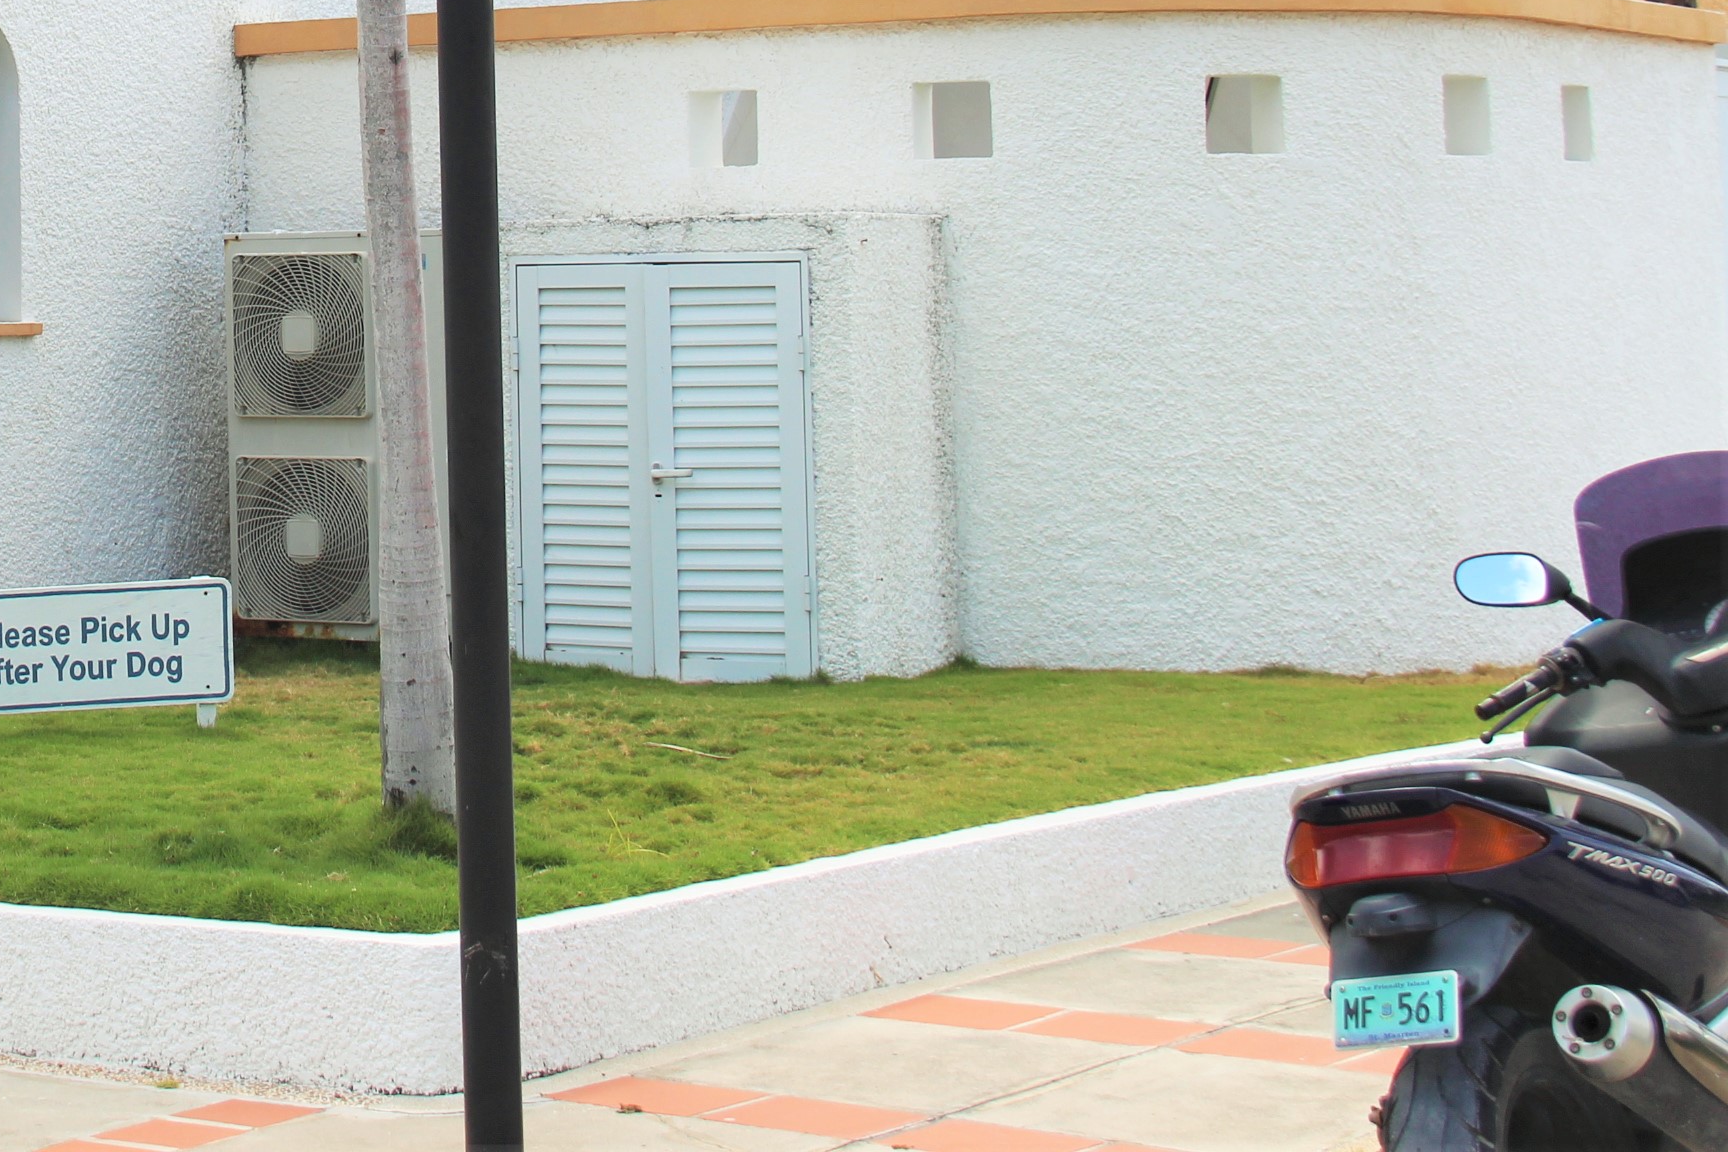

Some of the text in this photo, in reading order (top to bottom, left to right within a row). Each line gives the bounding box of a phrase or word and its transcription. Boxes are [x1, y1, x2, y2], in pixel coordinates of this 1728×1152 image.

[80, 614, 142, 644] Pick
[151, 613, 190, 646] Up
[51, 654, 117, 682] Your
[126, 651, 183, 684] Dog
[1340, 801, 1402, 819] YAMAHA
[1374, 982, 1404, 991] Friendly
[1407, 979, 1430, 987] Island
[1344, 989, 1445, 1030] MF 561
